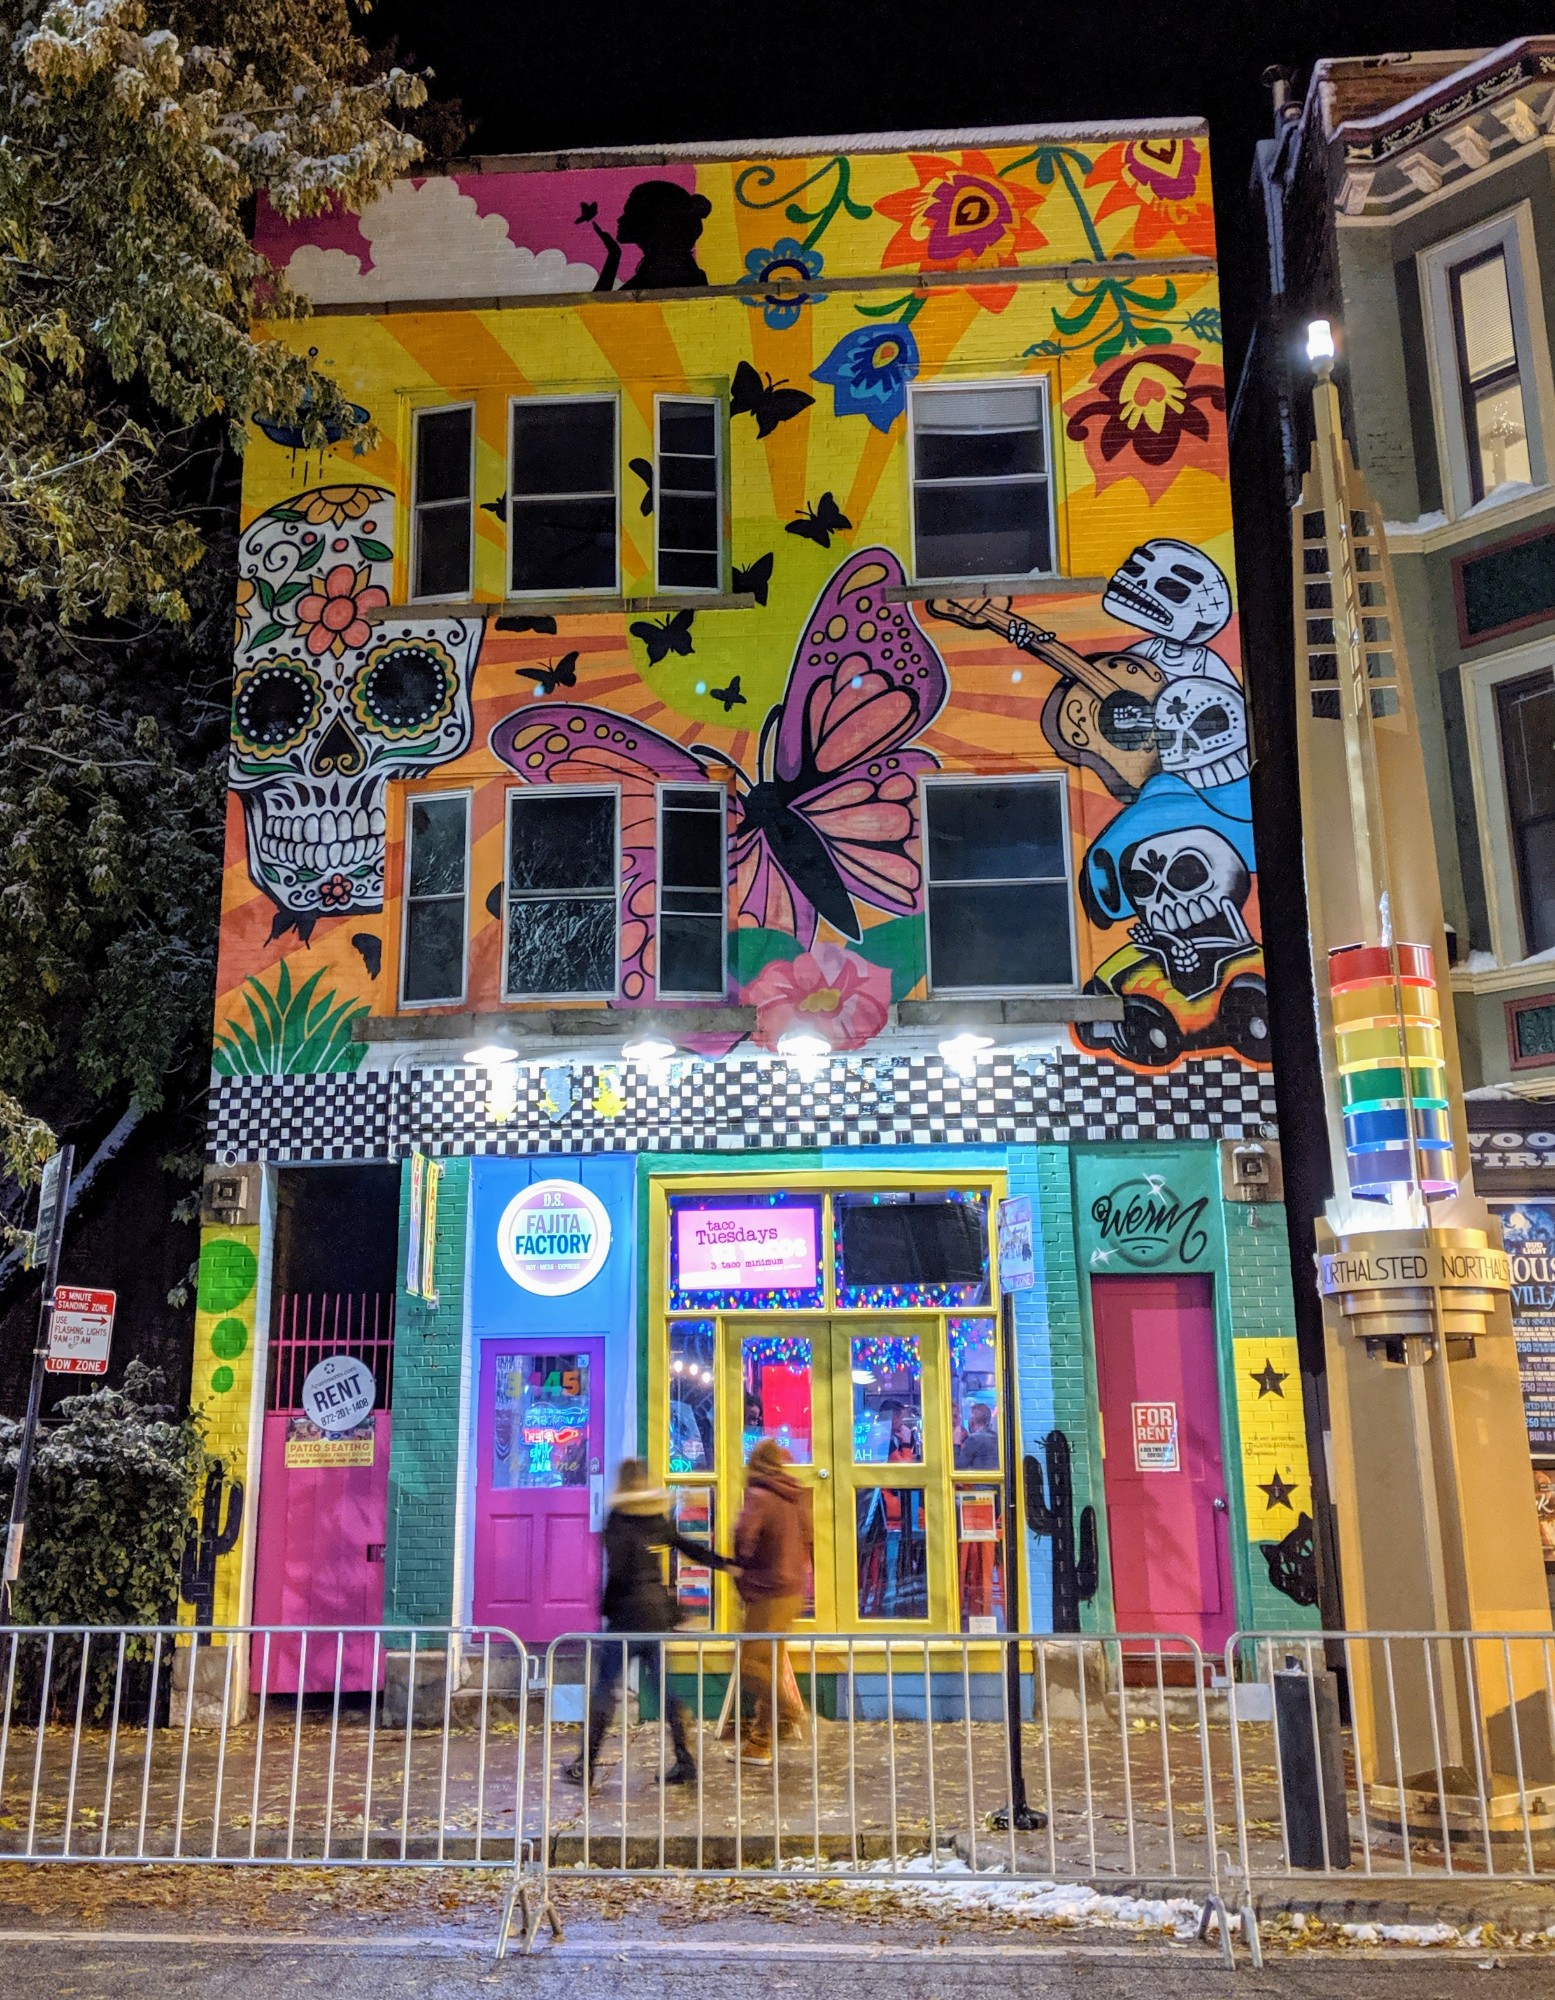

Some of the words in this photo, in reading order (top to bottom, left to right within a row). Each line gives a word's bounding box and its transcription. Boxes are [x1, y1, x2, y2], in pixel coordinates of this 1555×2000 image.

[543, 1193, 564, 1207] D.S.
[526, 1213, 581, 1234] FAJITA
[706, 1220, 736, 1231] taco
[695, 1227, 778, 1245] Tuesdays
[515, 1233, 592, 1255] FACTORY
[711, 1261, 717, 1270] 3
[721, 1261, 741, 1269] taco
[745, 1257, 784, 1267] minimum
[59, 1290, 66, 1300] 15
[69, 1291, 93, 1302] MINUTE
[57, 1300, 89, 1311] STANDING
[91, 1303, 109, 1313] ZONE
[56, 1315, 68, 1325] USE
[54, 1325, 84, 1336] FLASHING
[86, 1327, 107, 1337] LIGHTS
[1517, 1342, 1532, 1353] 250
[51, 1358, 72, 1370] TOW
[75, 1360, 102, 1372] ZONE
[313, 1373, 362, 1413] RENT
[1136, 1408, 1173, 1427] FOR
[1137, 1426, 1173, 1441] RENT
[1529, 1431, 1545, 1441] BUD
[290, 1444, 321, 1453] PATIO
[324, 1442, 370, 1452] SEATING
